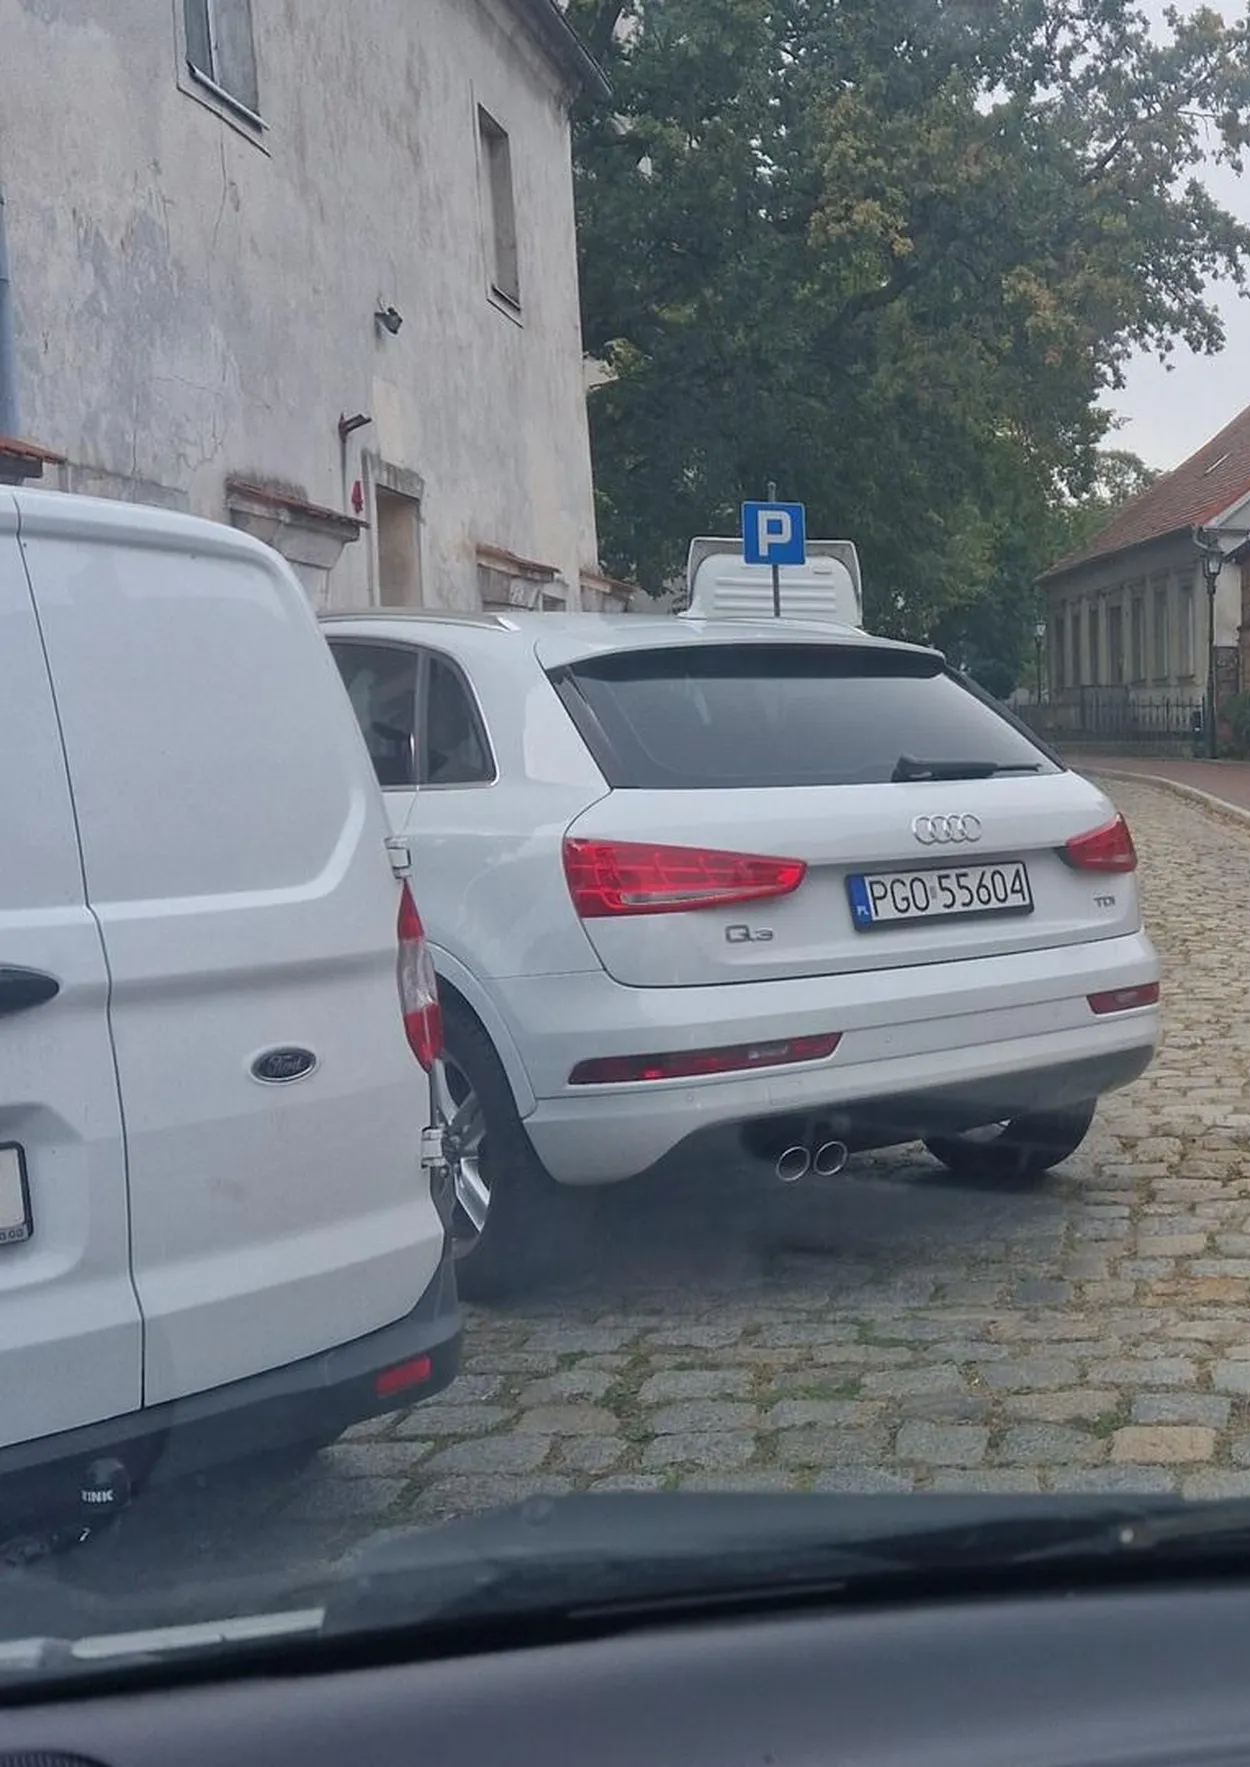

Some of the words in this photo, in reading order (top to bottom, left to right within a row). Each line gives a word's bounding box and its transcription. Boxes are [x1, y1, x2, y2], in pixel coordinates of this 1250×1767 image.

[757, 510, 792, 557] P
[868, 876, 930, 917] PGO
[937, 867, 1027, 909] 55604
[725, 924, 774, 943] Q3
